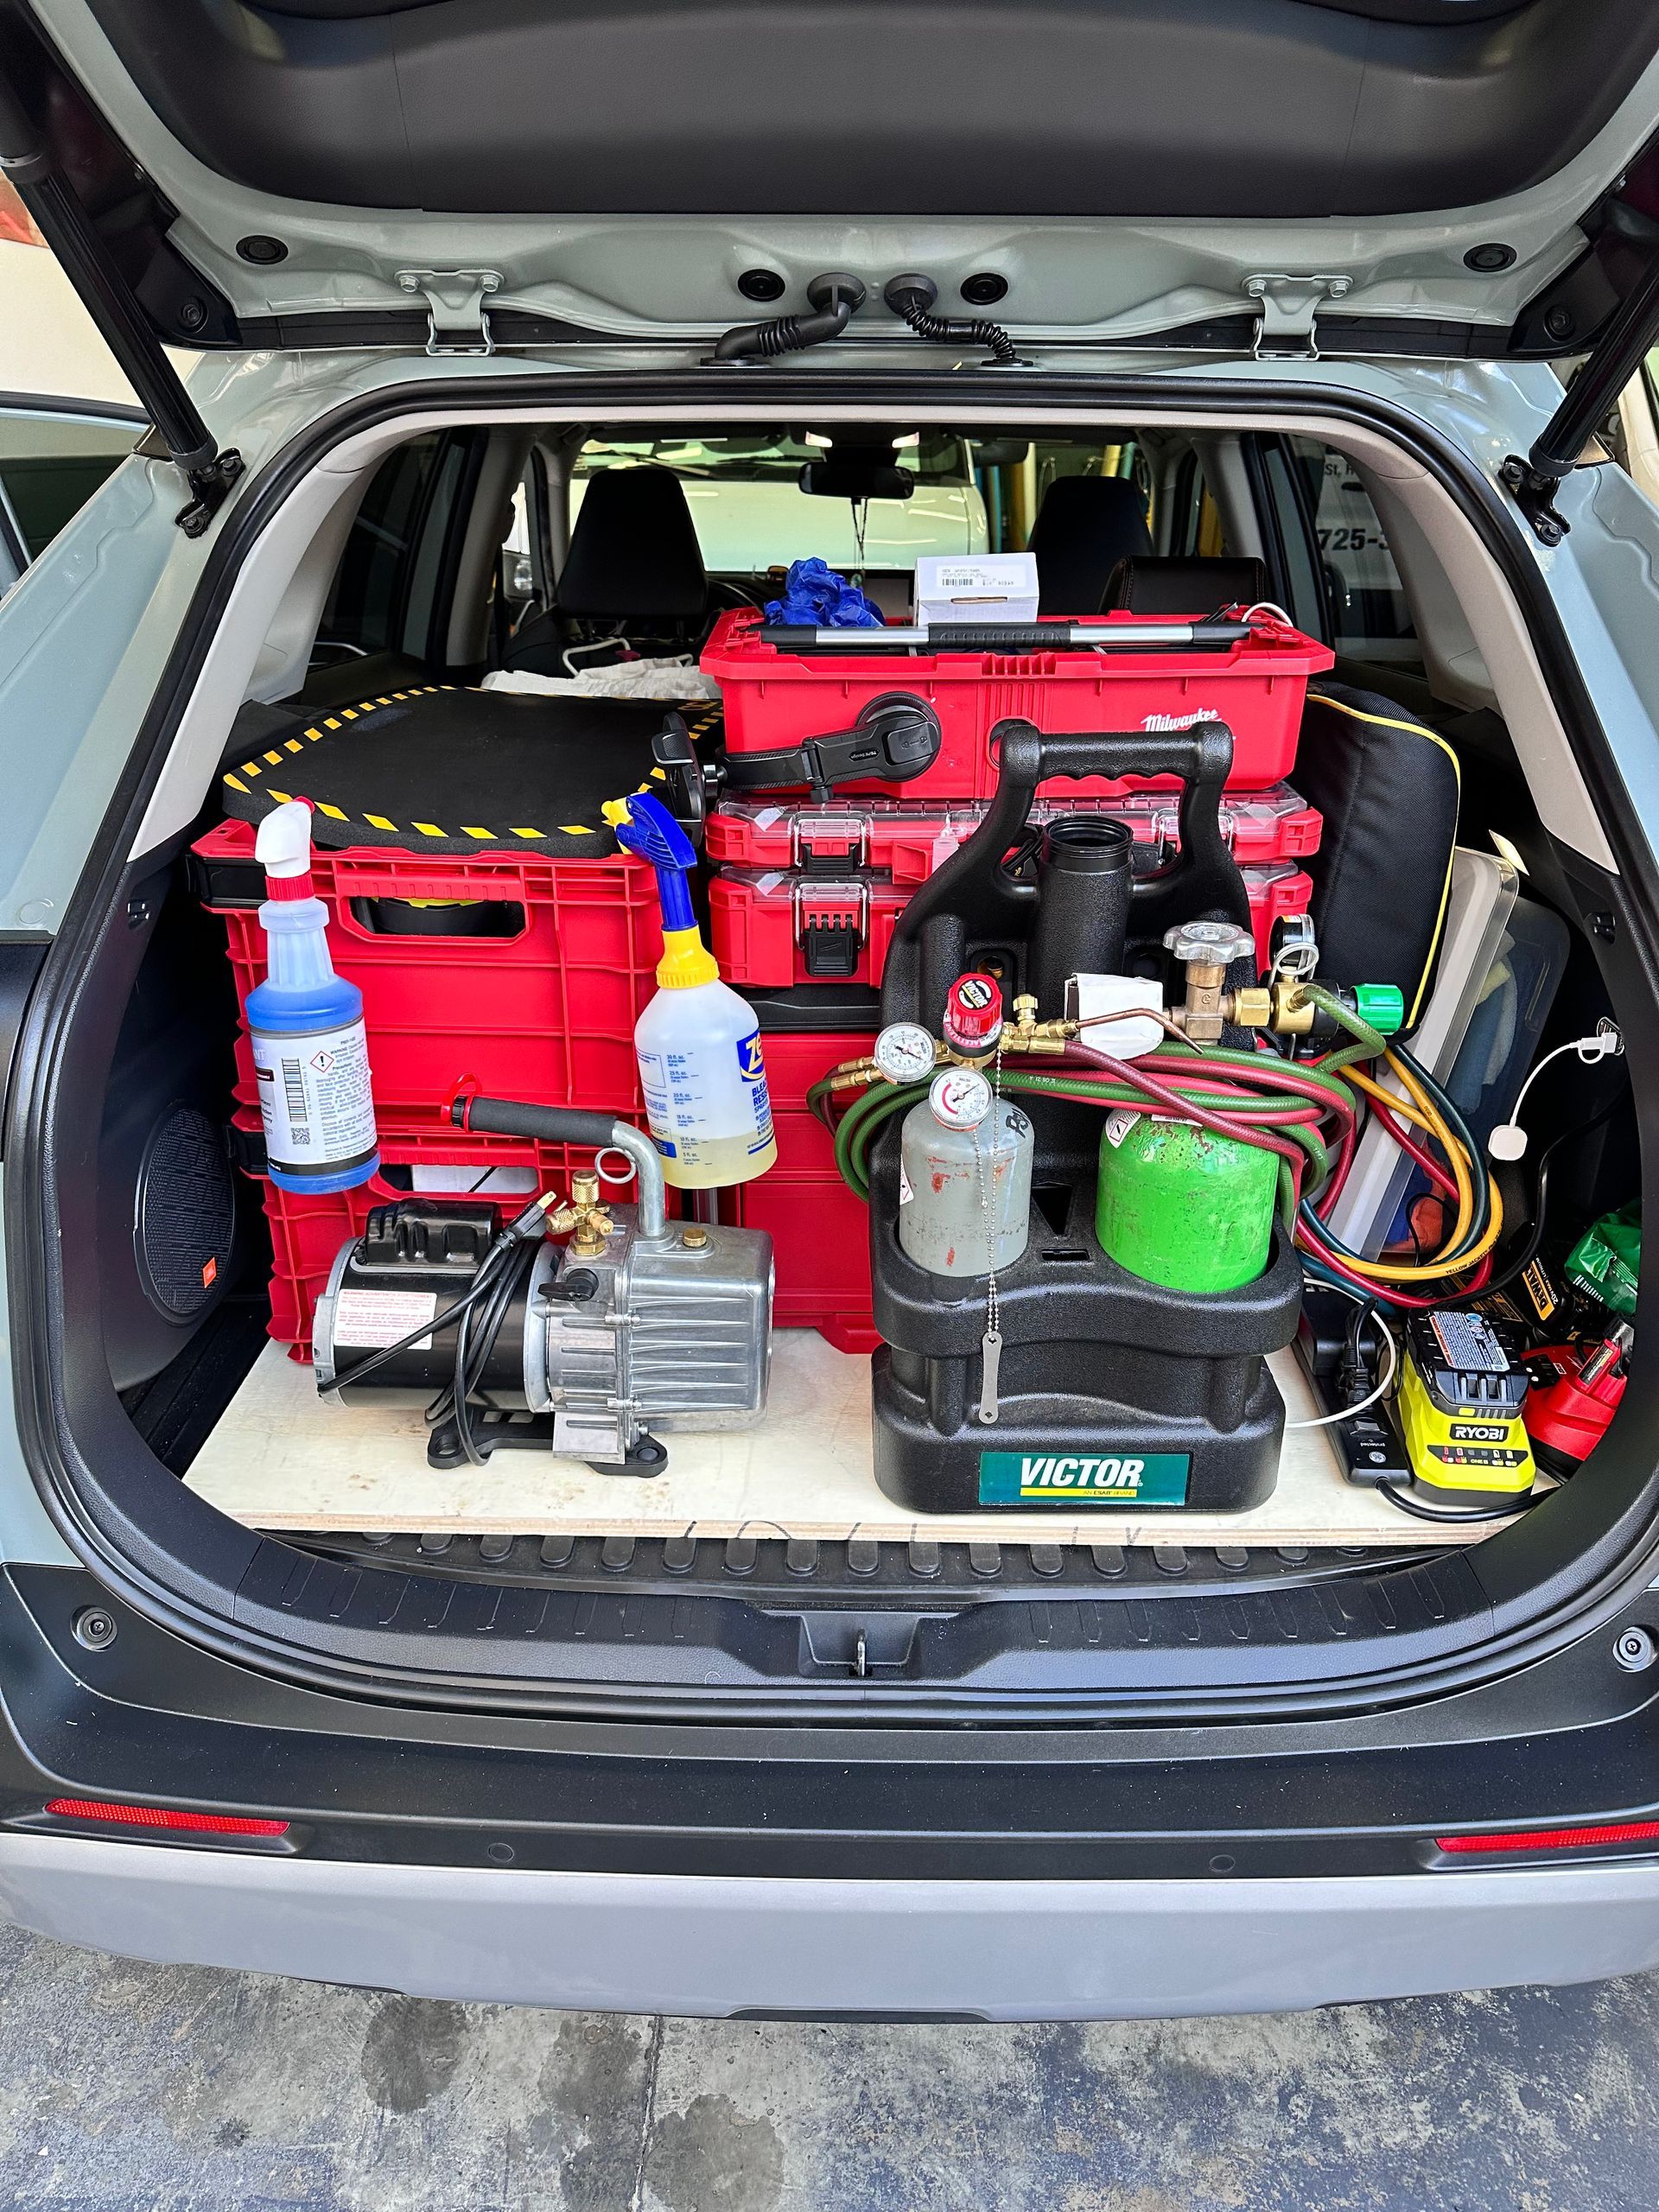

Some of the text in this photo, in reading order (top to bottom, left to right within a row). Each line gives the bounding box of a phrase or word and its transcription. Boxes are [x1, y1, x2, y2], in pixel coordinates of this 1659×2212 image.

[1140, 708, 1223, 733] Milwaukee
[963, 979, 989, 1008] VICTOR
[945, 1021, 980, 1046] ACETYLENE
[1446, 1264, 1467, 1274] YELLOW
[1535, 1257, 1548, 1275] LITHIUM
[1455, 1426, 1504, 1440] RYOBI
[1020, 1458, 1145, 1487] VICTOR
